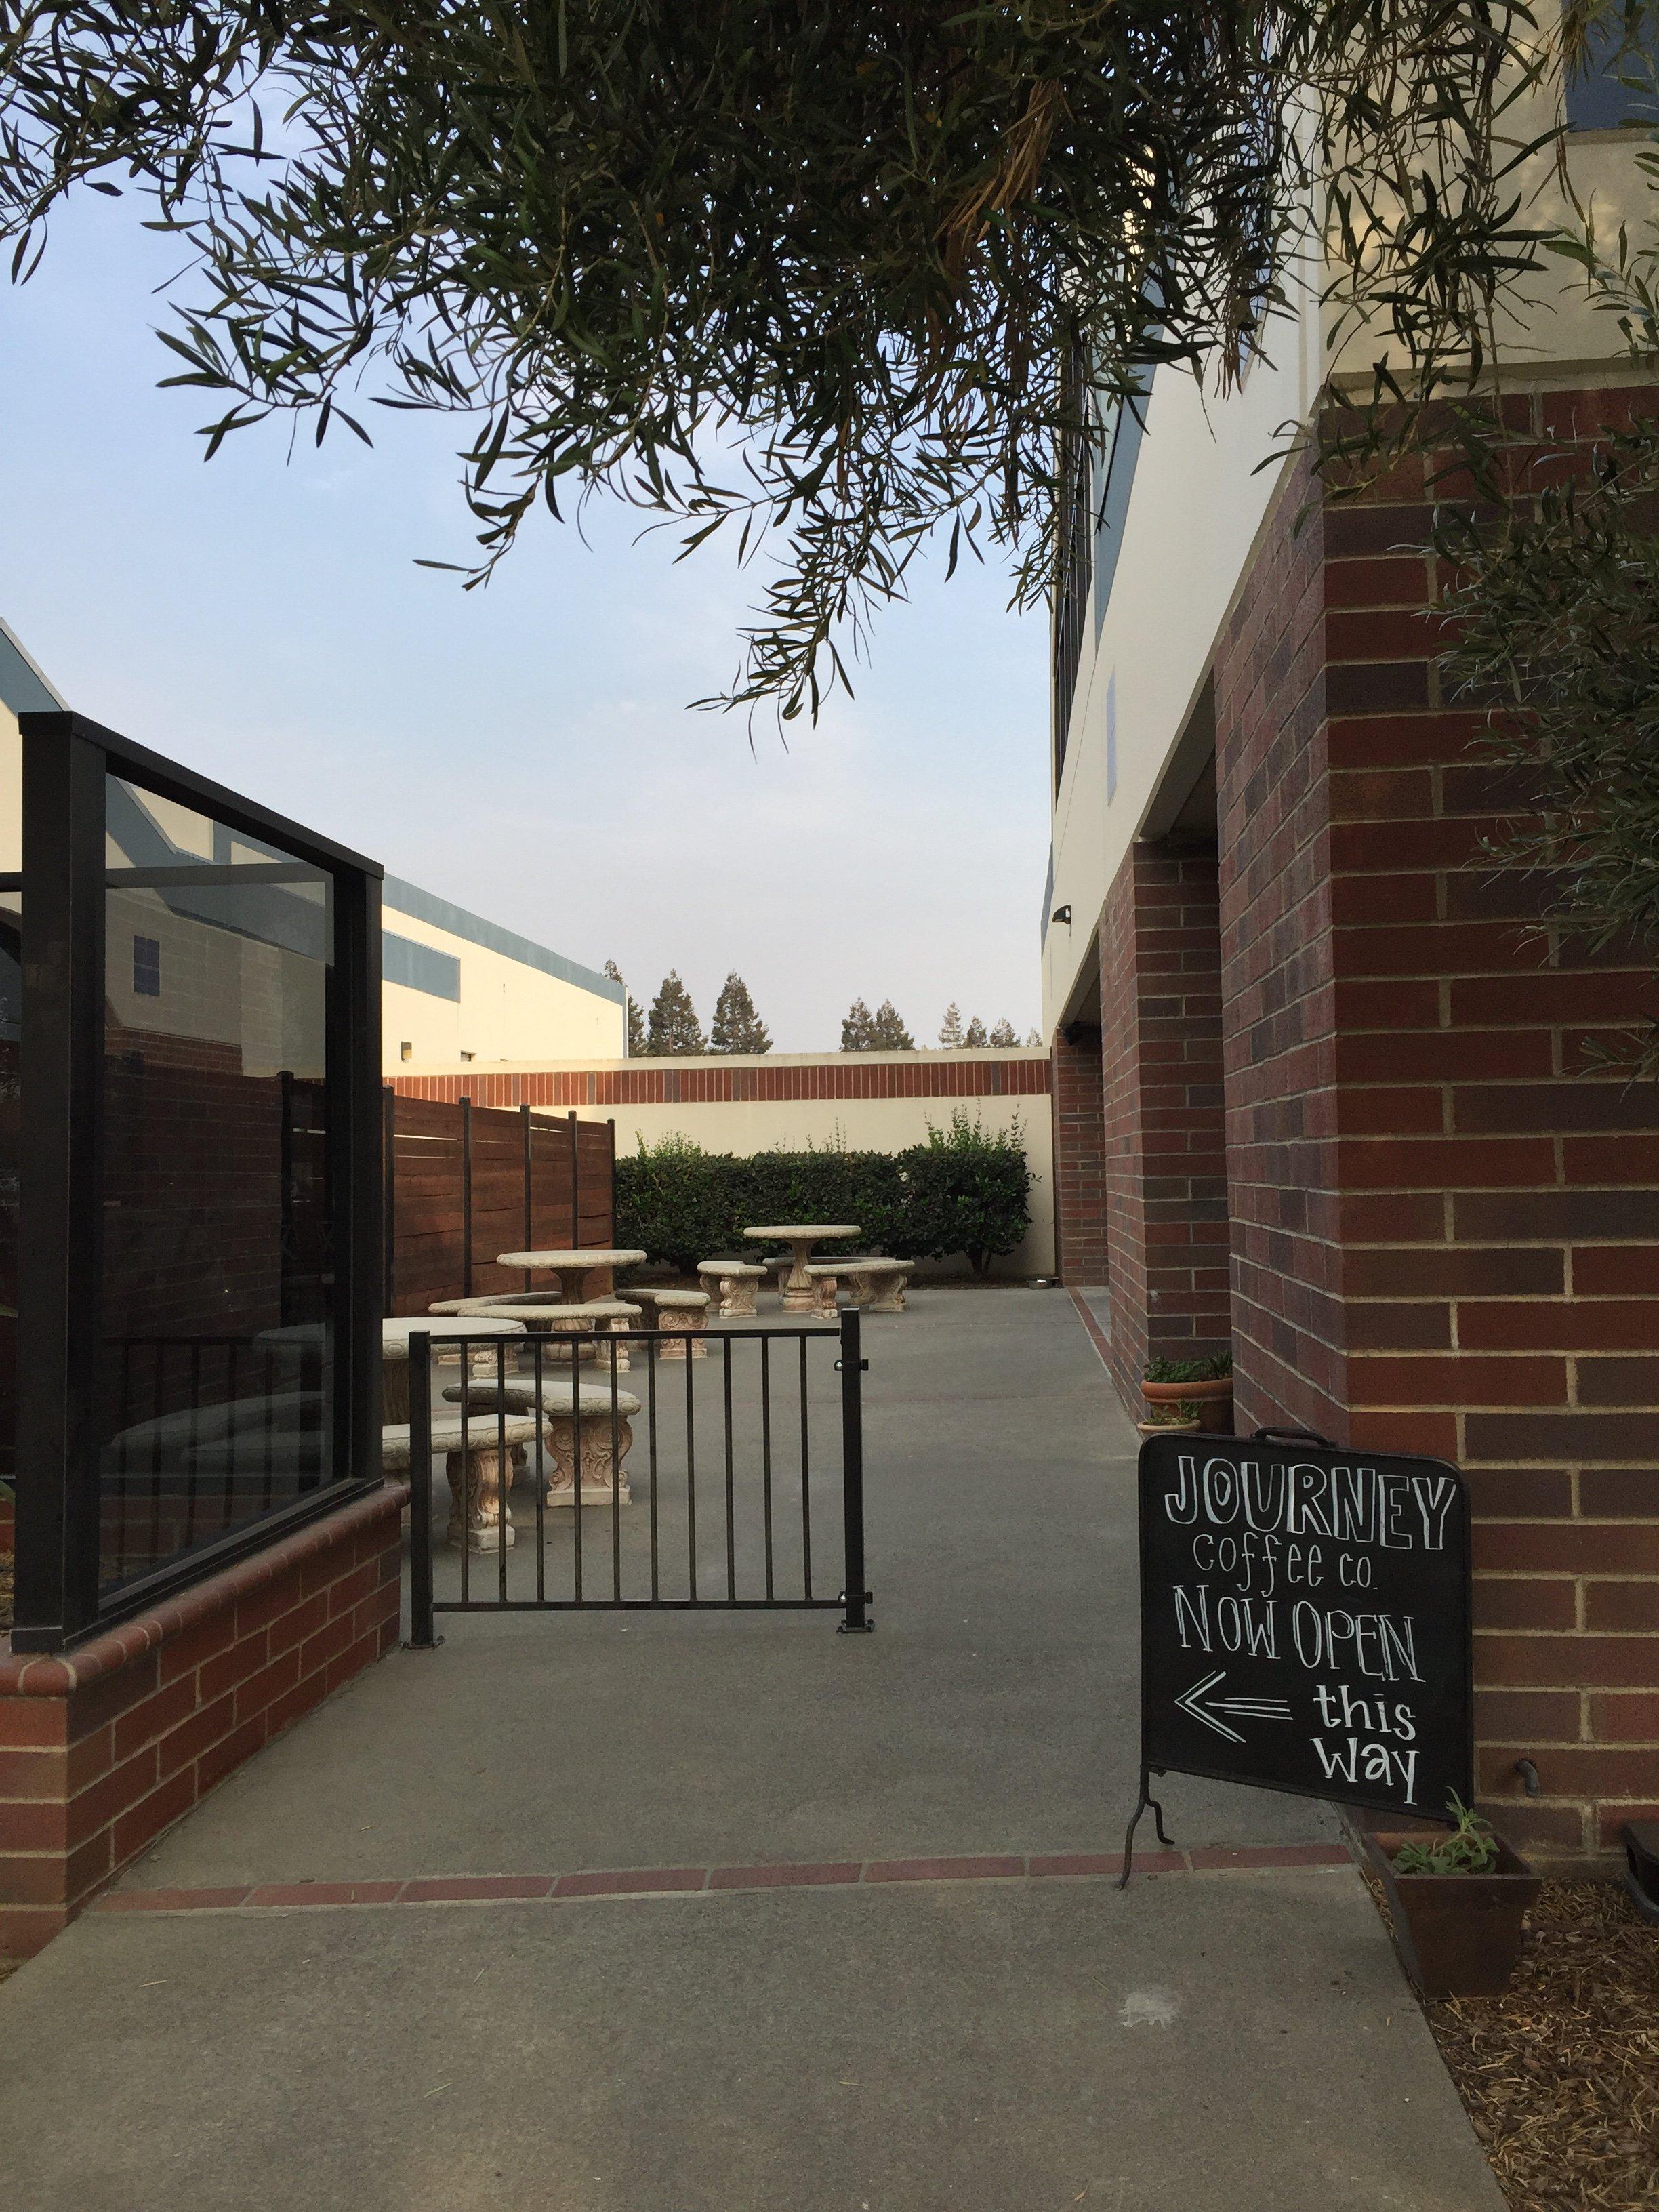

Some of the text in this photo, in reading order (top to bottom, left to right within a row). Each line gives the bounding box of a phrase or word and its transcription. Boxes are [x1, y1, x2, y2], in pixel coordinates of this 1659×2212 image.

[1164, 1456, 1456, 1550] JOURNEY
[1172, 1585, 1426, 1683] NOW OPEN
[1313, 1685, 1416, 1740] this
